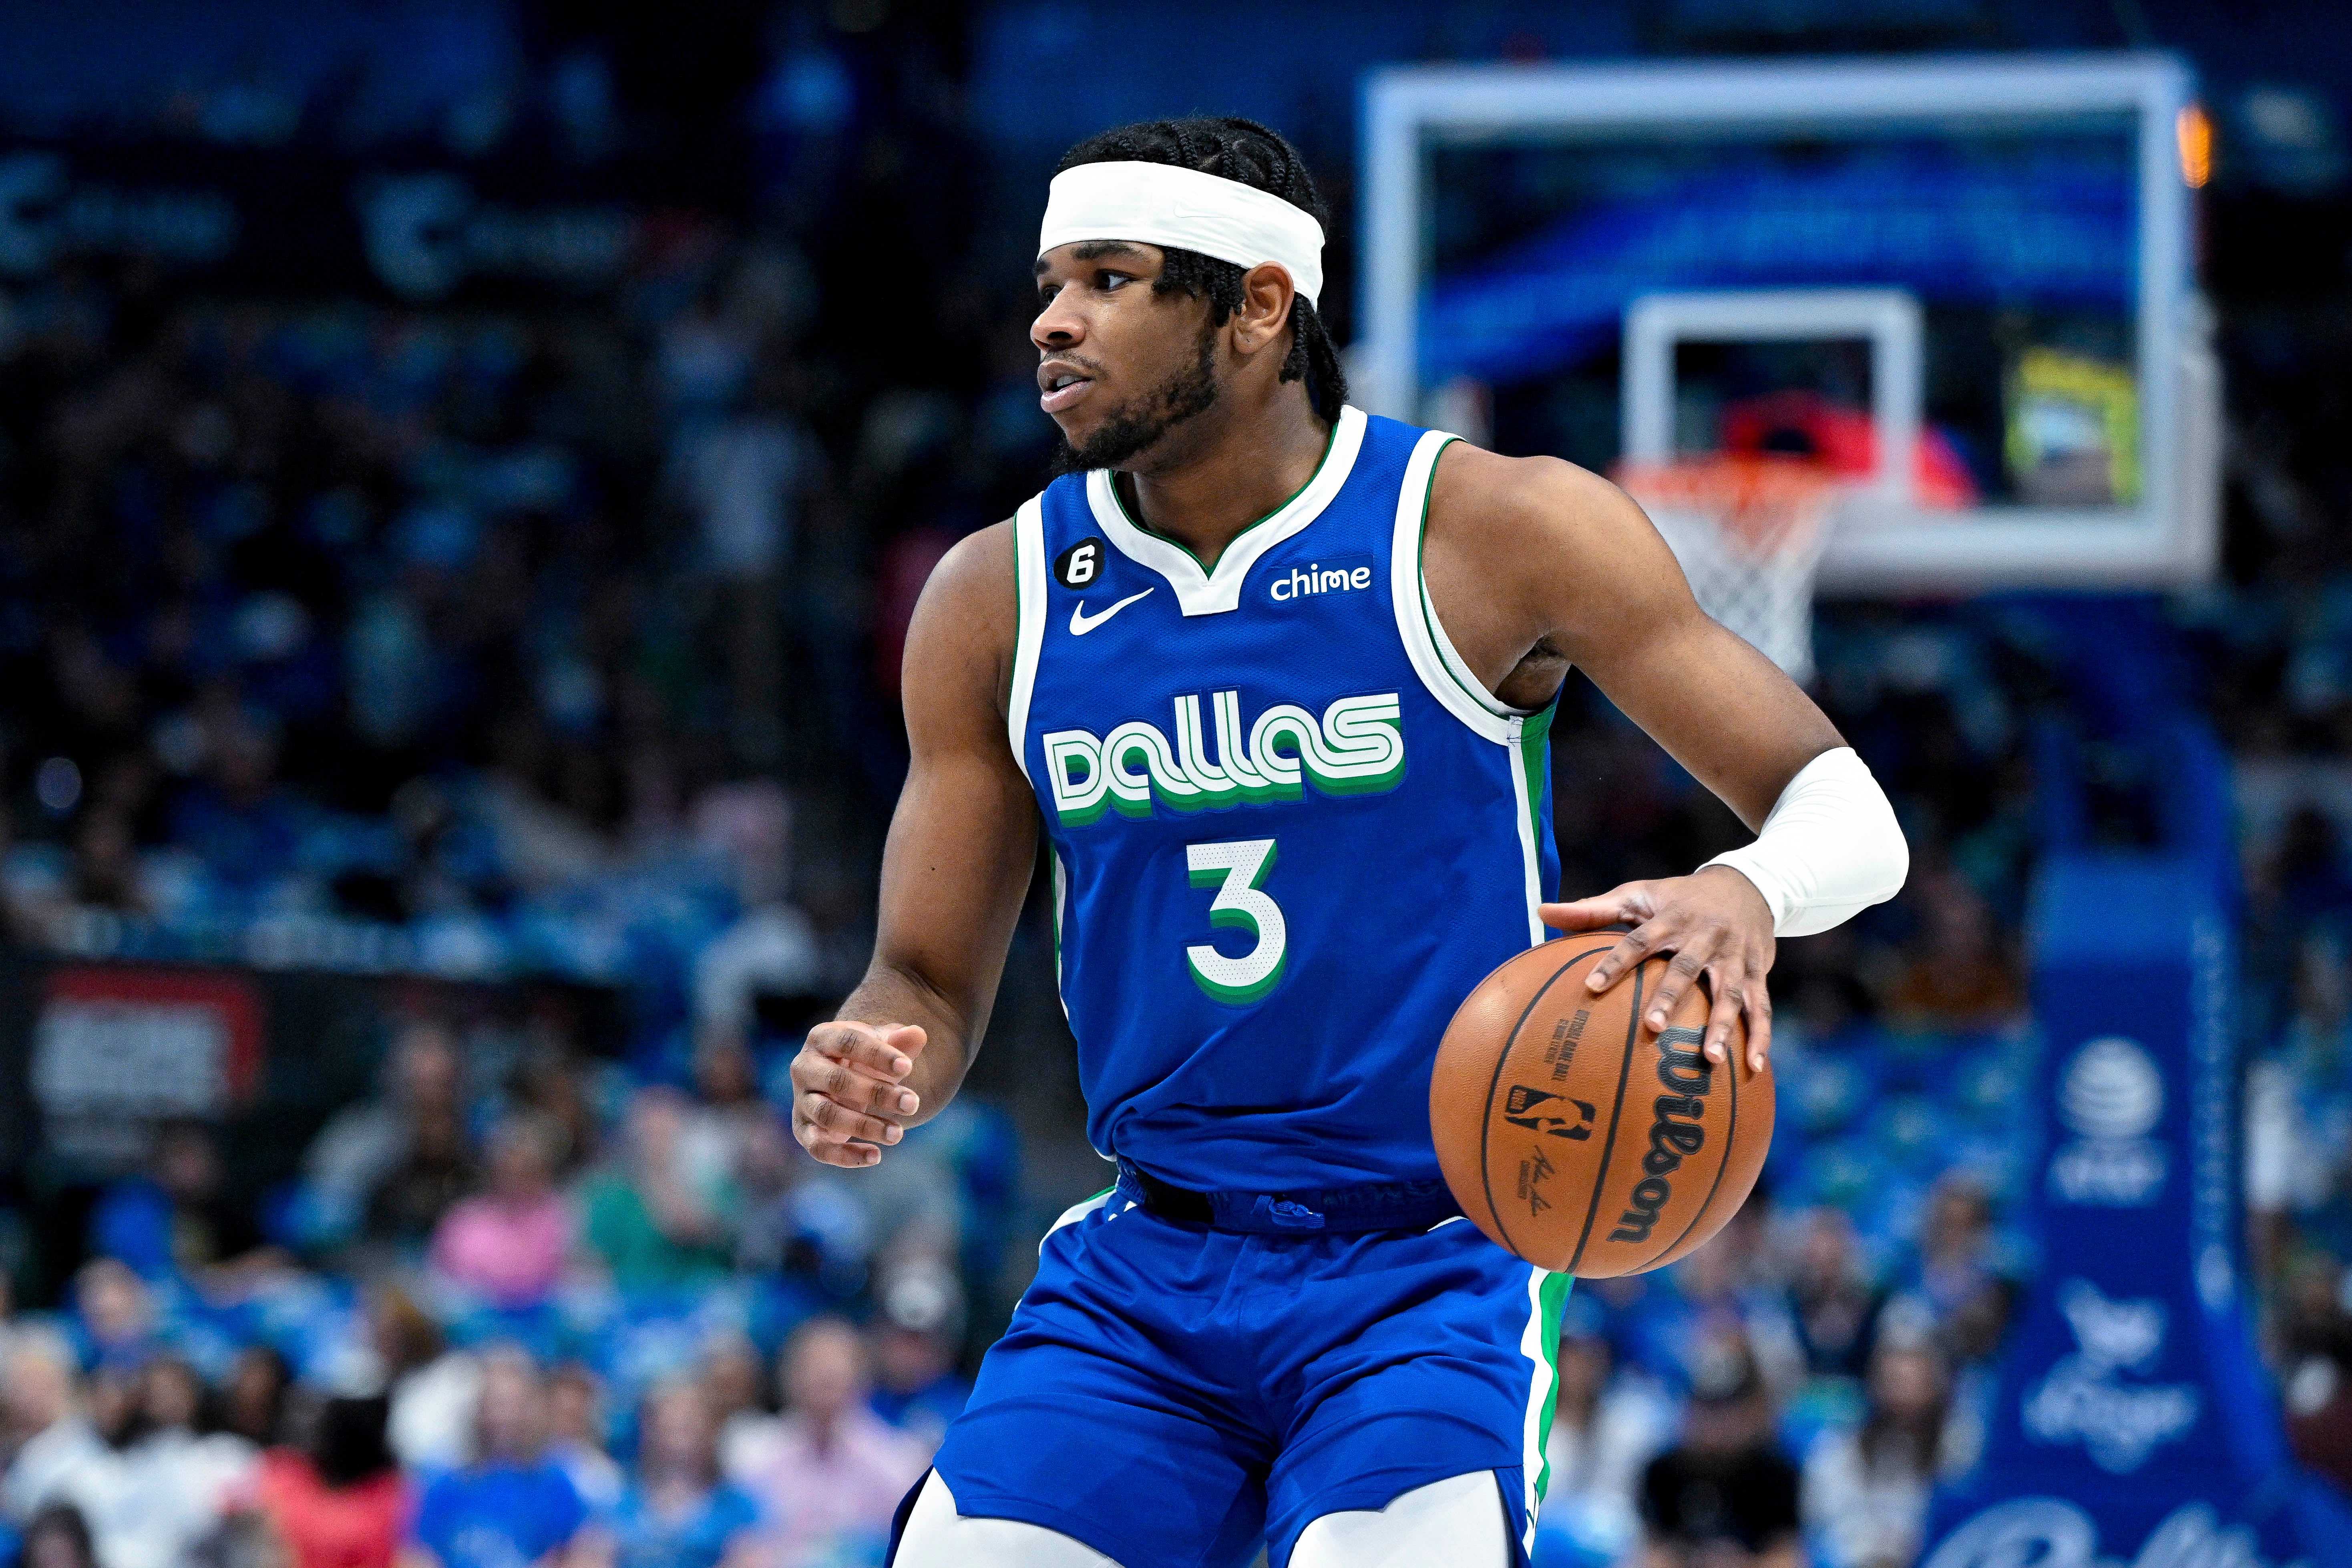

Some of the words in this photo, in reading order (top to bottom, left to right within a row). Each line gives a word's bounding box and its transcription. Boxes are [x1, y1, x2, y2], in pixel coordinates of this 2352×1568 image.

[1066, 545, 1095, 584] 6
[1270, 563, 1371, 601] chime
[1043, 690, 1405, 829] Dallas
[1186, 838, 1287, 1005] 3
[1606, 1024, 1712, 1243] Wilson
